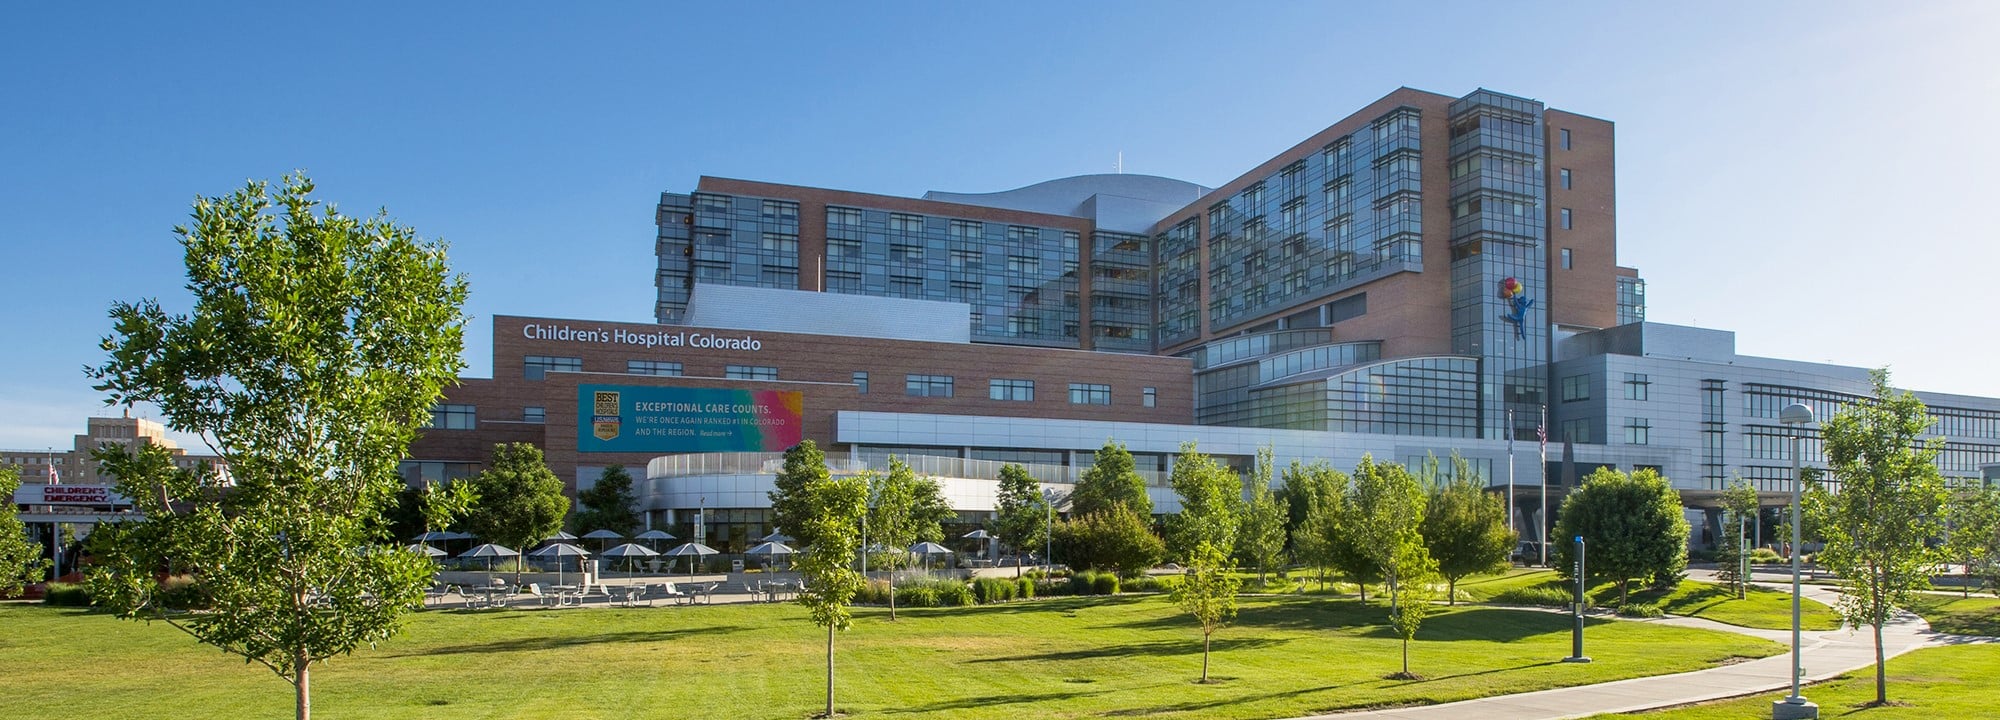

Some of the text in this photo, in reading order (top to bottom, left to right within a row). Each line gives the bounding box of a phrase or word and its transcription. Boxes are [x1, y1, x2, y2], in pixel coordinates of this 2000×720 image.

[523, 324, 761, 351] Children's Hospital Colorado
[596, 392, 618, 402] BEST
[635, 401, 772, 414] EXCEPTIONAL CARE COUNTS.
[635, 416, 658, 424] WE'RE
[660, 416, 679, 424] ONCE
[680, 416, 702, 424] AGAIN
[704, 417, 731, 425] RANKED
[749, 418, 785, 426] COLORADO
[635, 428, 651, 436] AND
[652, 428, 666, 436] THE
[668, 428, 697, 436] REGION.
